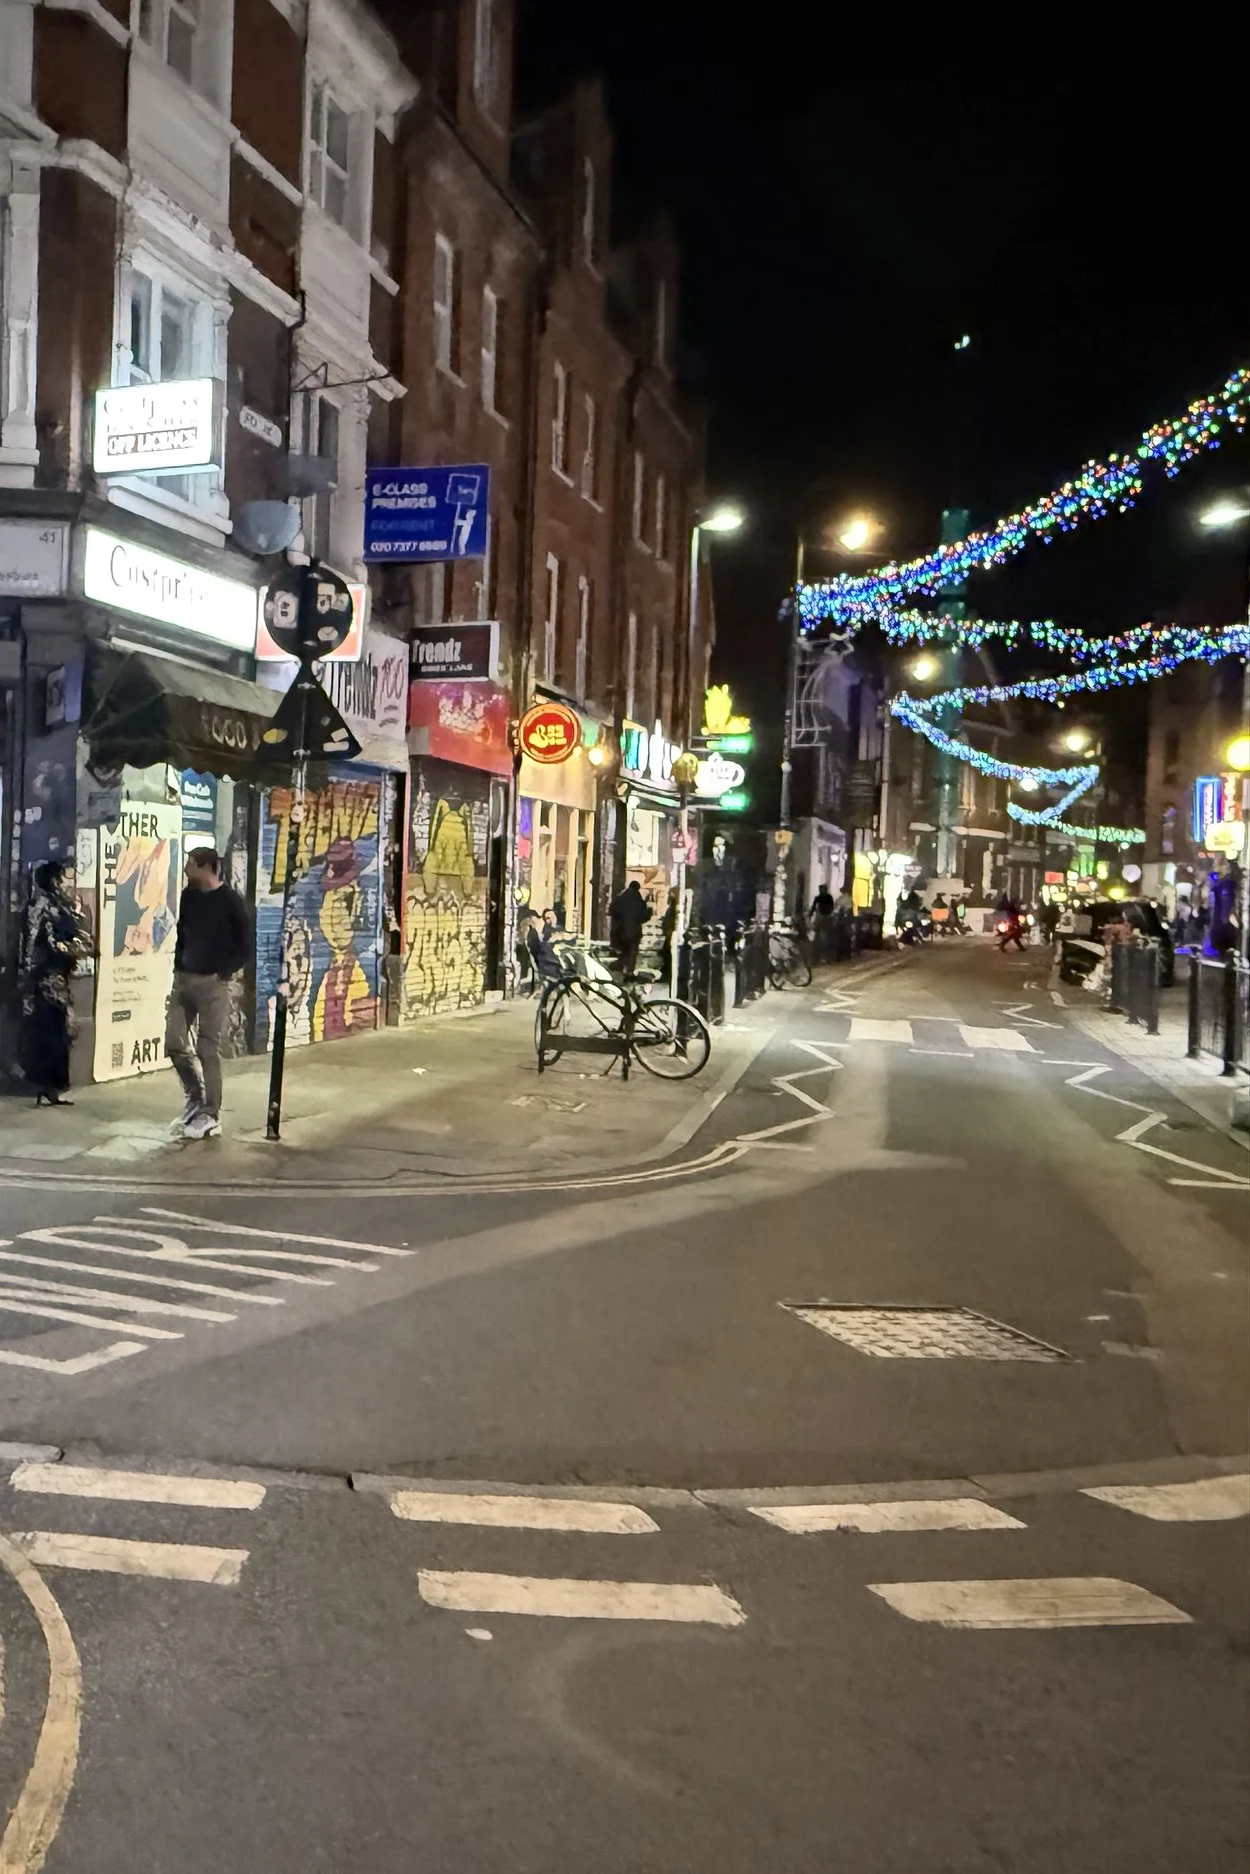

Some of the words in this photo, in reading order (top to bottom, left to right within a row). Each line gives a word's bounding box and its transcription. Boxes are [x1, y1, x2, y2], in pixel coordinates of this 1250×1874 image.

[119, 811, 161, 840] THER
[103, 842, 122, 910] THE
[130, 1036, 162, 1067] ART
